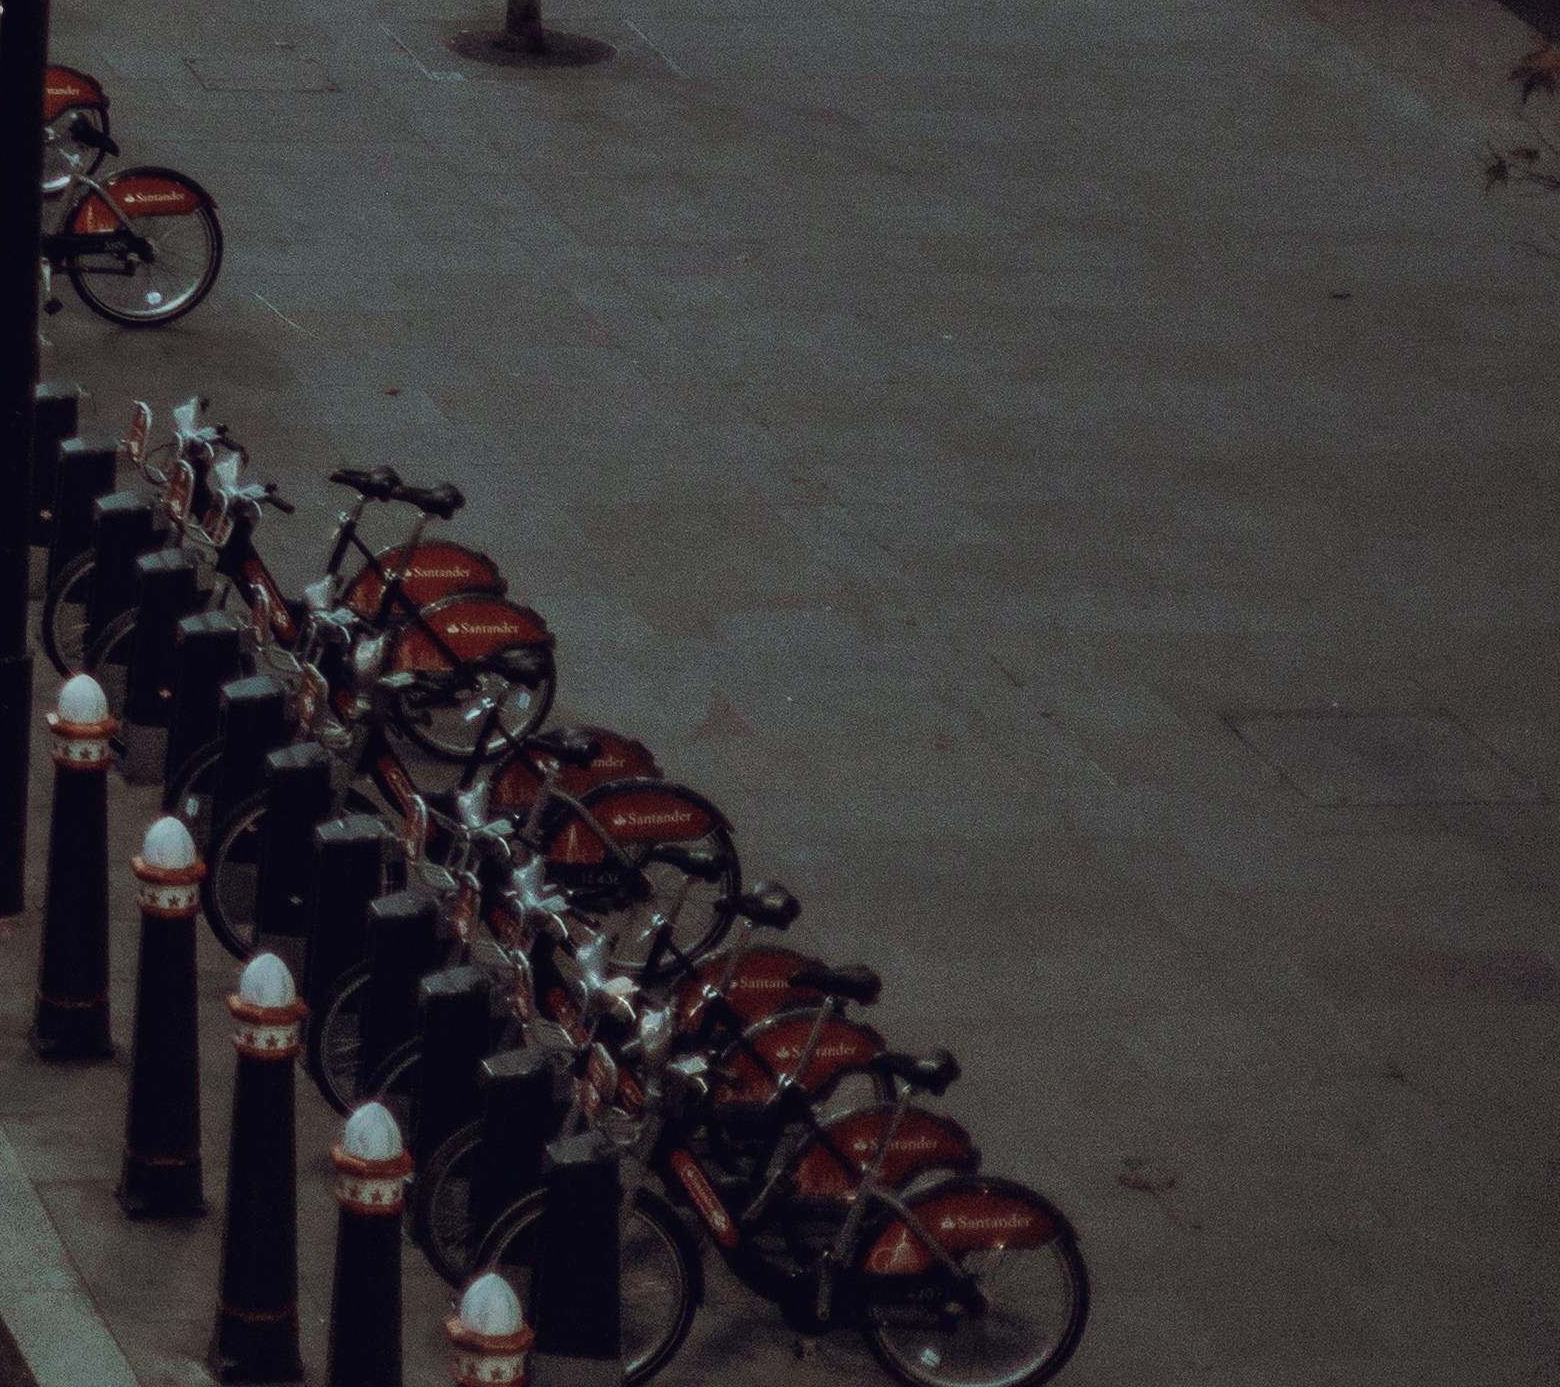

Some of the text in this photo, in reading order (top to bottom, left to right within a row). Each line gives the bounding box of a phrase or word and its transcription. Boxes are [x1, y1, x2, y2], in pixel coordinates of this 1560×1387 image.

[136, 192, 185, 203] Santander
[413, 566, 471, 579] Santander
[460, 622, 520, 635] Santander
[628, 811, 692, 825] Santander
[740, 976, 790, 989] Santan
[792, 1043, 858, 1058] Stander
[957, 1214, 1033, 1229] Santander
